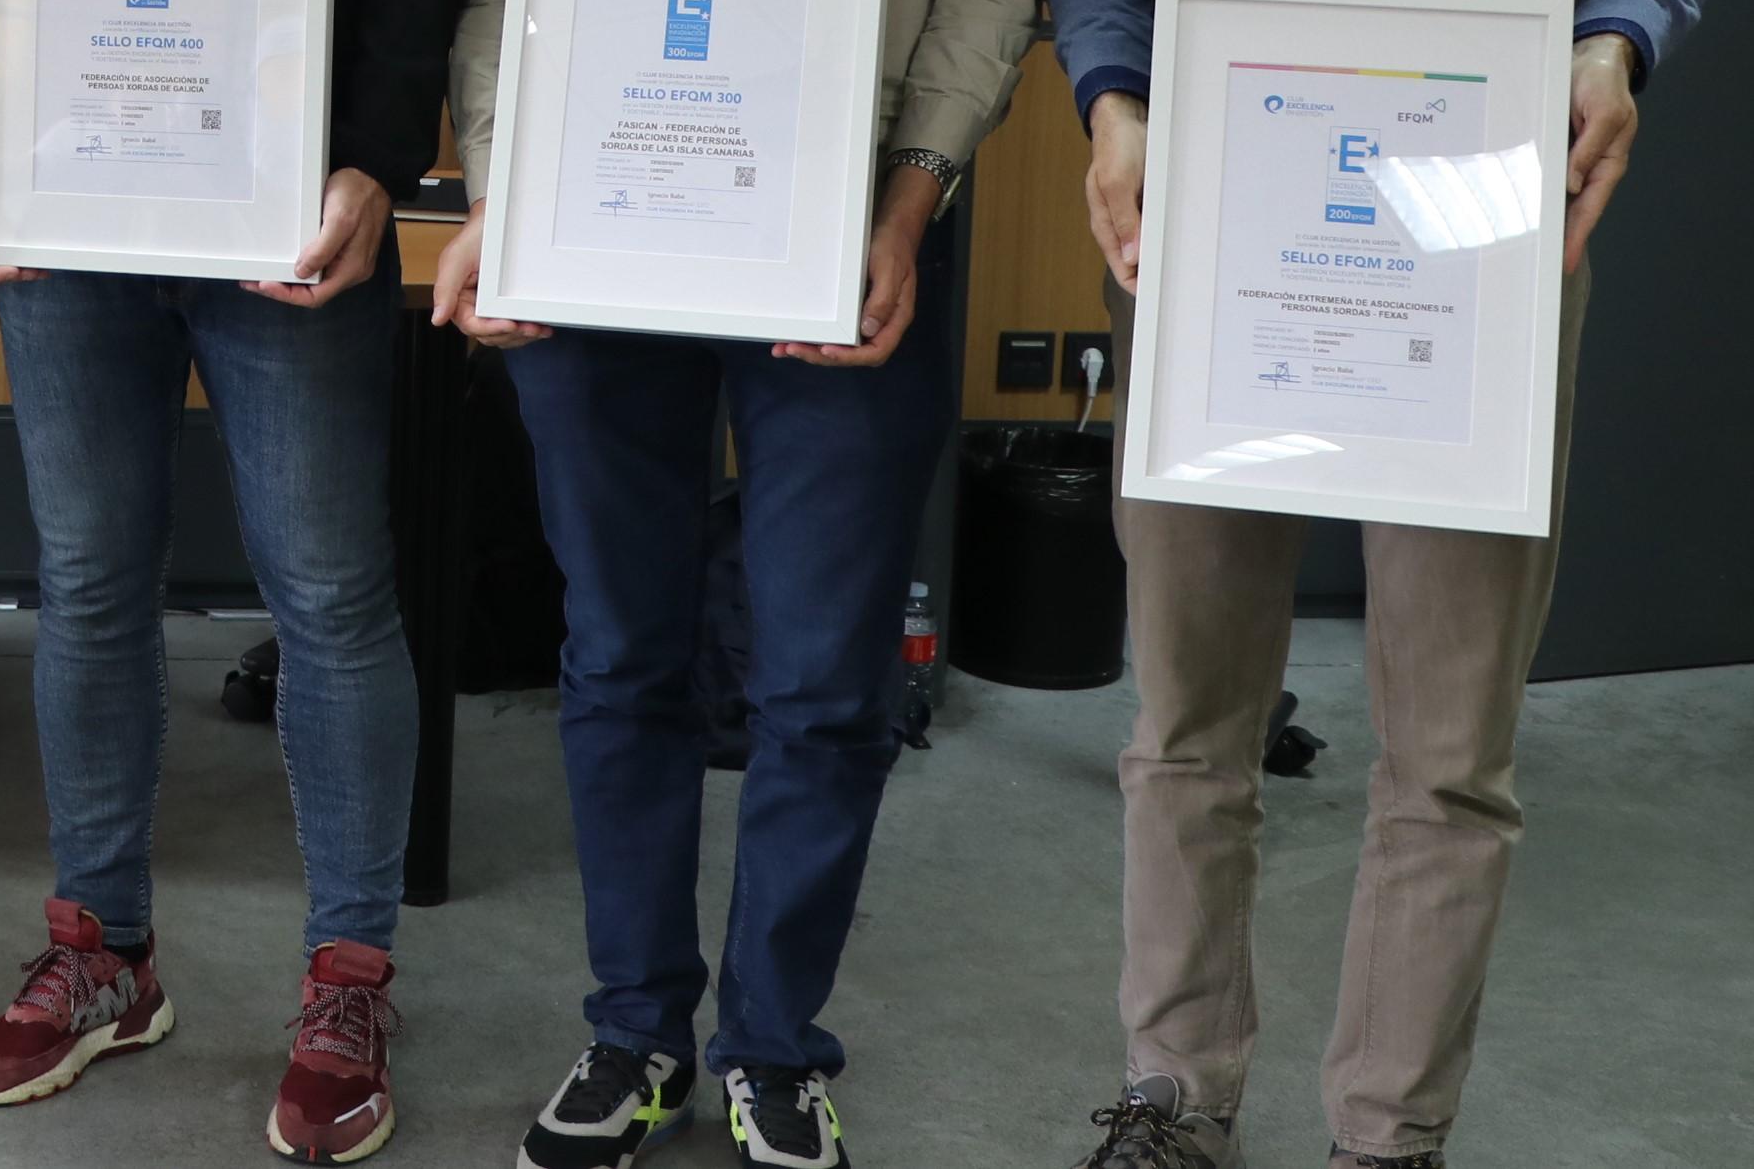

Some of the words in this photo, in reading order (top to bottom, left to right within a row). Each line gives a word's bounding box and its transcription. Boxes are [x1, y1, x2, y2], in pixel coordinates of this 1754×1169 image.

[91, 36, 132, 47] SELLO
[136, 37, 175, 49] EFQM
[180, 38, 204, 49] 400
[668, 47, 686, 56] 300
[81, 73, 130, 82] FEDERACIÓN
[623, 88, 666, 100] SELLO
[671, 90, 712, 102] EFQM
[717, 93, 742, 104] 300
[1286, 102, 1334, 111] EXCELENCIA
[1398, 113, 1433, 123] EFQM
[618, 121, 658, 130] FASICAN
[666, 123, 725, 134] FEDERACIÓN
[728, 127, 741, 135] DE
[609, 132, 678, 142] ASOCIACIONES
[696, 136, 748, 146] PERSONAS
[601, 142, 639, 151] SORDAS
[677, 146, 703, 155] ISLAS
[706, 147, 754, 158] CANARIAS
[1329, 209, 1351, 219] 200
[1281, 250, 1329, 265] SELLO
[1335, 254, 1381, 269] EFQM
[1387, 258, 1414, 271] 200
[1238, 289, 1295, 301] FEDERACIÓN
[1298, 294, 1352, 305] EXTREMEÑA
[1356, 298, 1368, 306] DE
[1371, 300, 1439, 312] ASOCIACIONES
[1442, 305, 1454, 313] DE
[1281, 303, 1331, 314] PERSONAS
[1333, 307, 1370, 317] SORDAS
[1379, 311, 1408, 320] FEXAS
